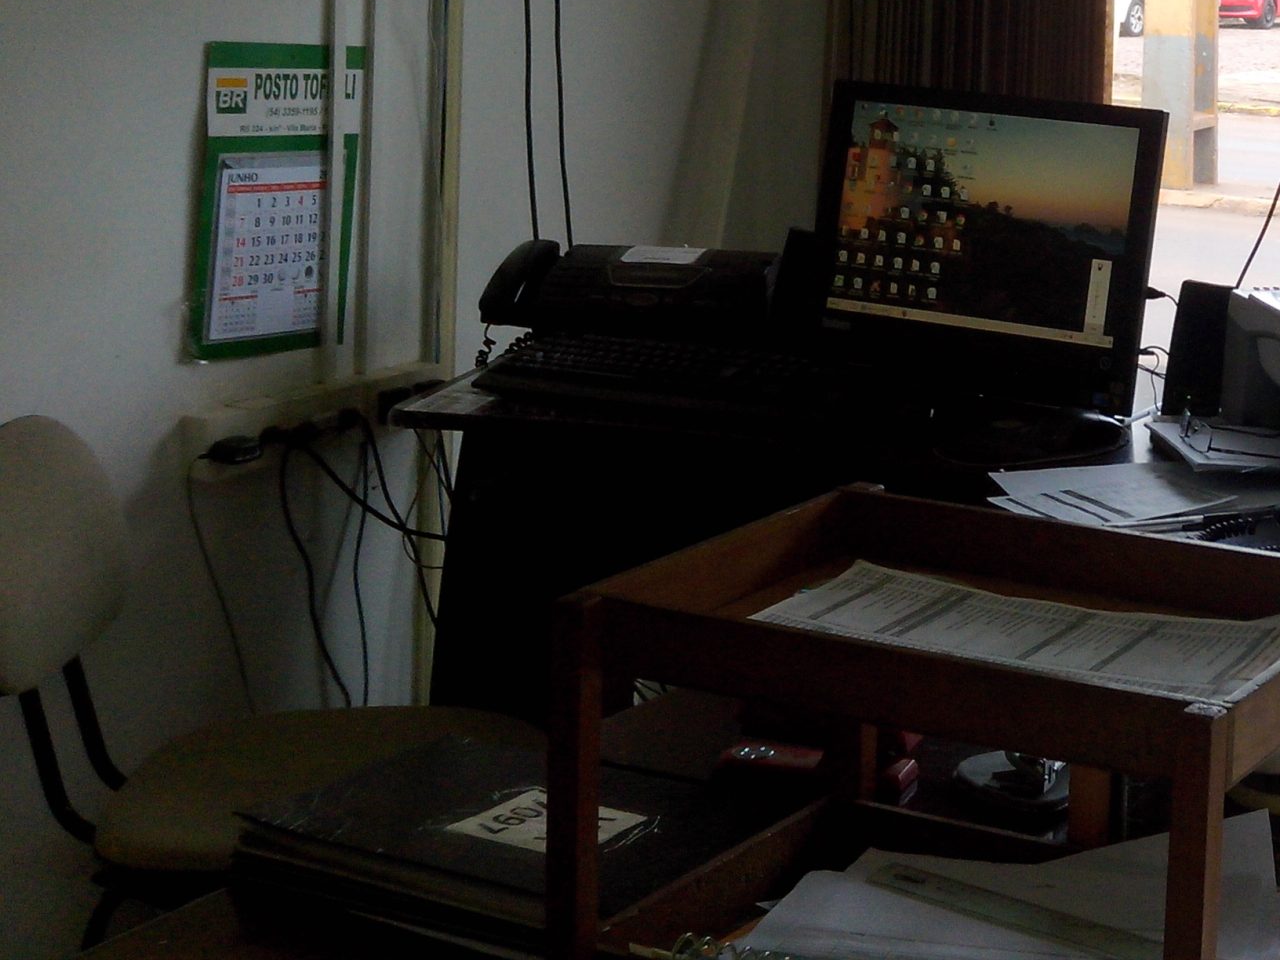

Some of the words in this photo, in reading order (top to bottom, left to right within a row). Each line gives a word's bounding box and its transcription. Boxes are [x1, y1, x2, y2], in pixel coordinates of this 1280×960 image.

[254, 73, 299, 100] POSTO
[218, 91, 245, 108] BR
[227, 172, 258, 184] JUNHO
[282, 215, 292, 226] 10
[295, 214, 304, 225] 11
[308, 213, 318, 224] 12
[236, 238, 246, 248] 14
[251, 236, 261, 247] 15
[266, 235, 276, 246] 16
[281, 234, 291, 245] 17
[294, 233, 303, 244] 18
[307, 232, 317, 243] 19
[233, 257, 244, 267] 21
[249, 255, 260, 267] 22
[264, 254, 275, 265] 23
[277, 253, 289, 264] 24
[292, 252, 302, 263] 25
[305, 250, 316, 261] 26
[232, 276, 244, 287] 28
[247, 274, 260, 285] 29
[262, 273, 274, 284] 30
